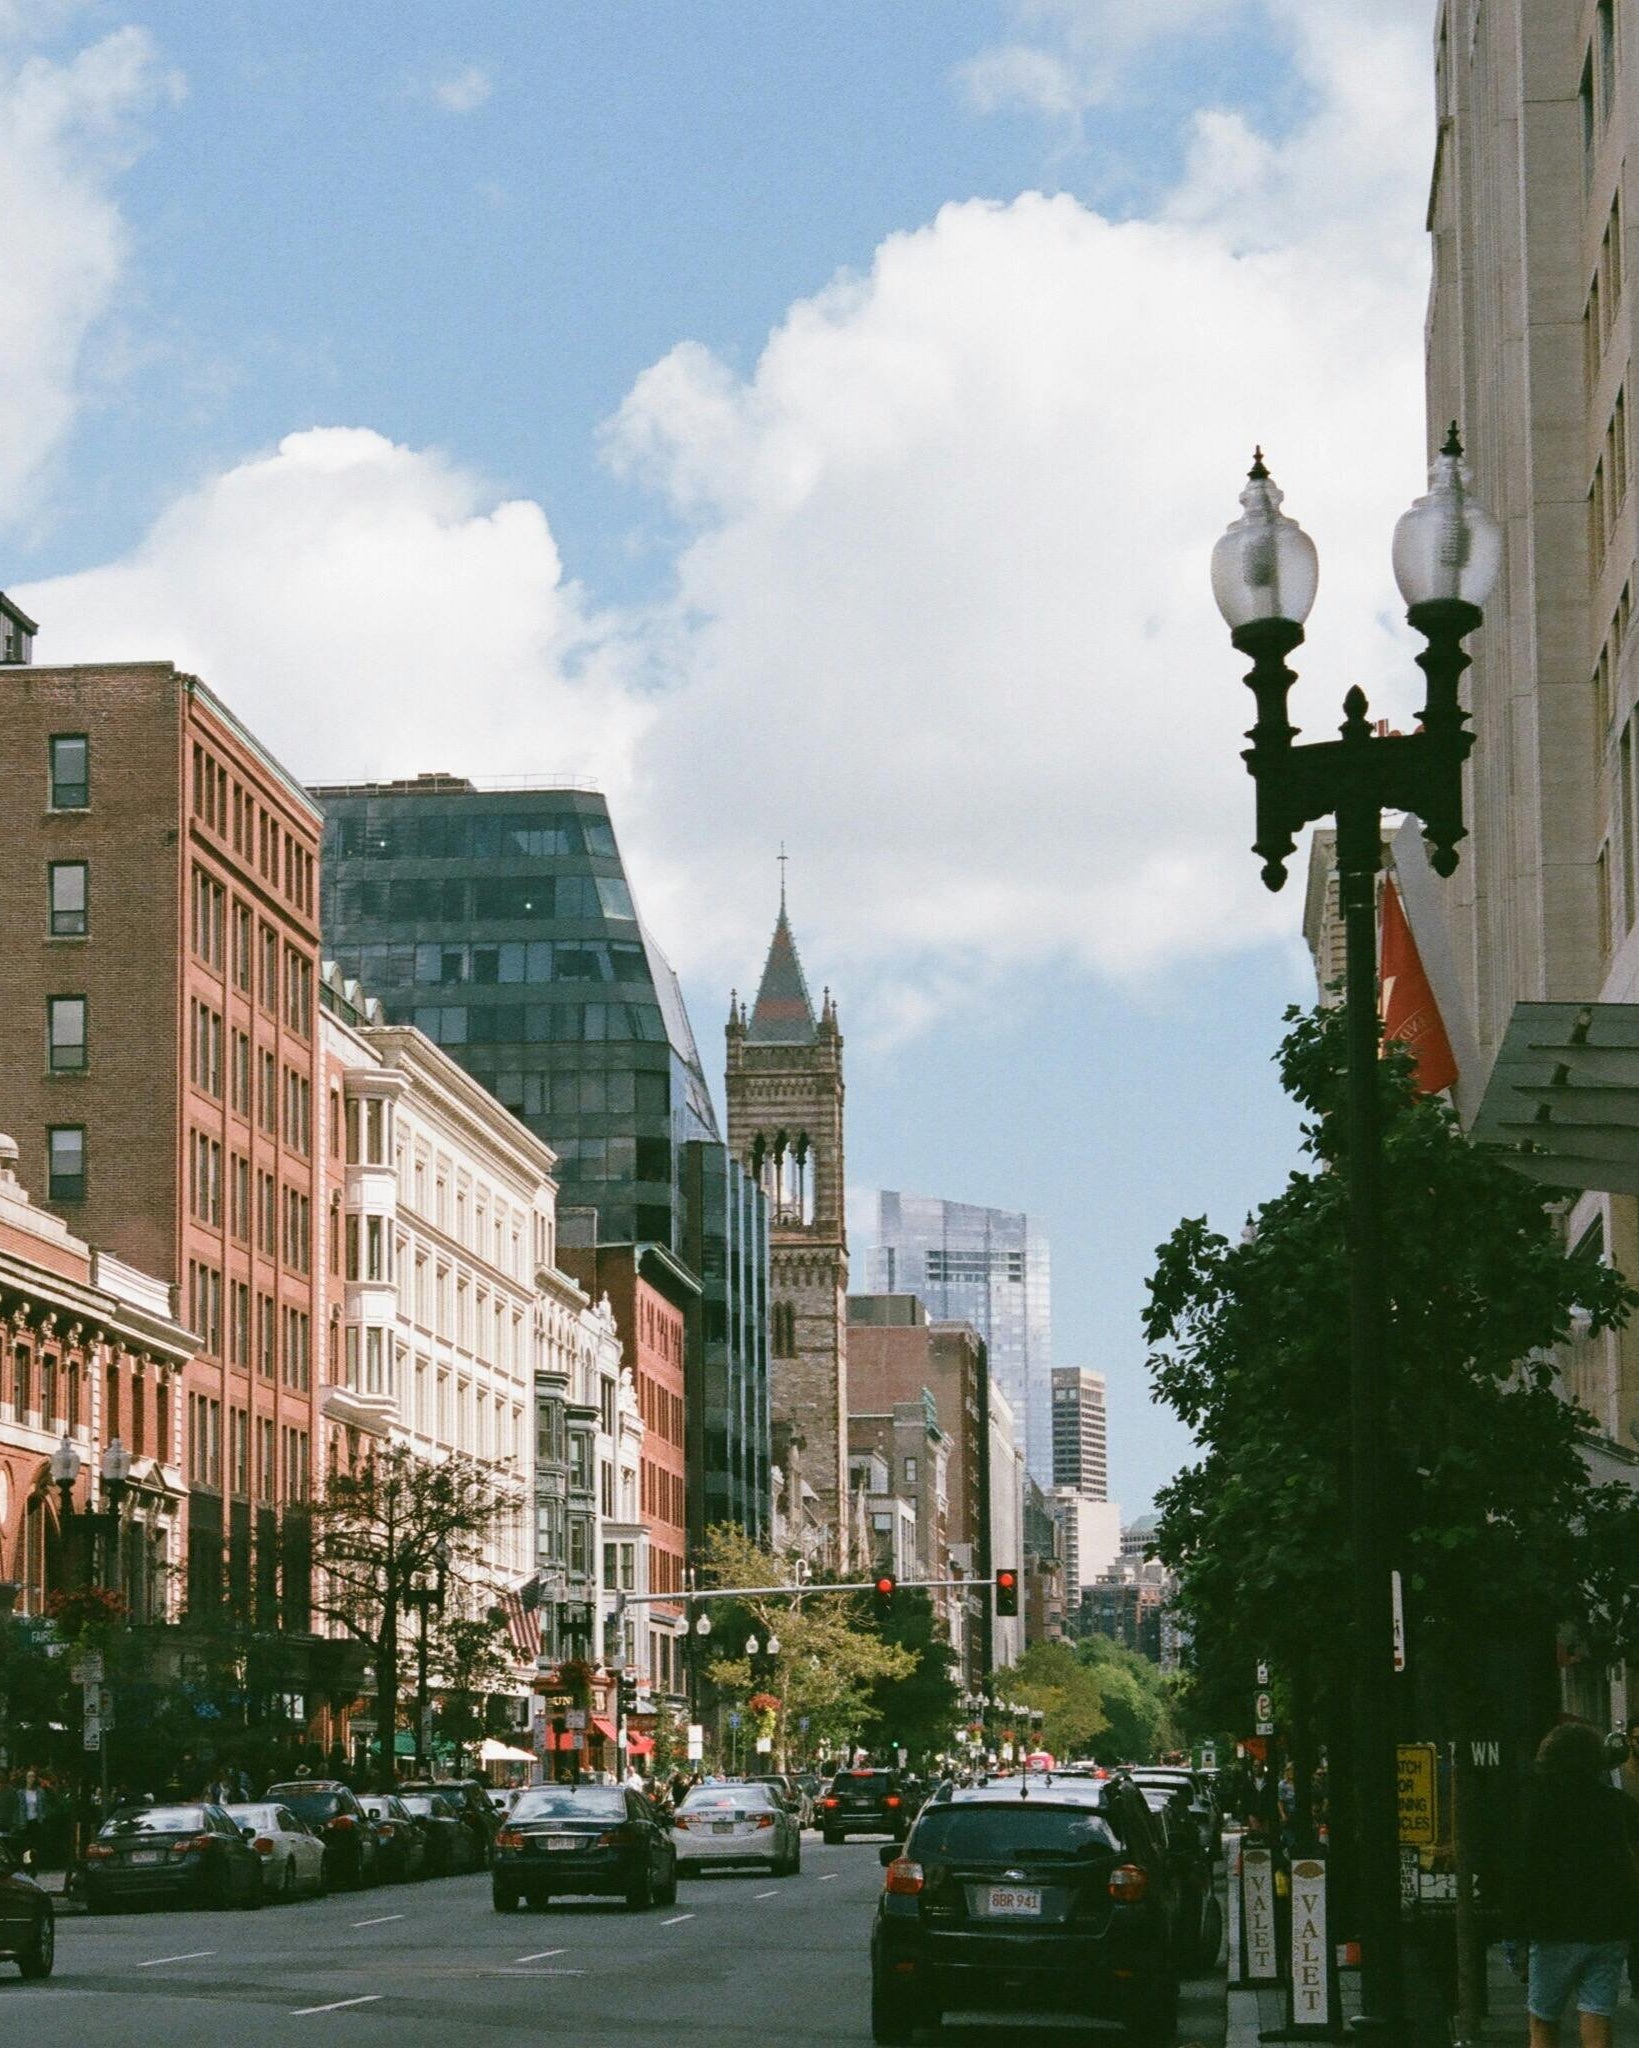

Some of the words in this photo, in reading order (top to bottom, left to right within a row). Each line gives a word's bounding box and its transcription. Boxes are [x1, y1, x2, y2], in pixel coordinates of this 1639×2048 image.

[1398, 1760, 1422, 1775] TCH
[1398, 1779, 1414, 1793] OR
[1251, 1876, 1270, 1967] VALET
[1301, 1894, 1321, 2010] VALET
